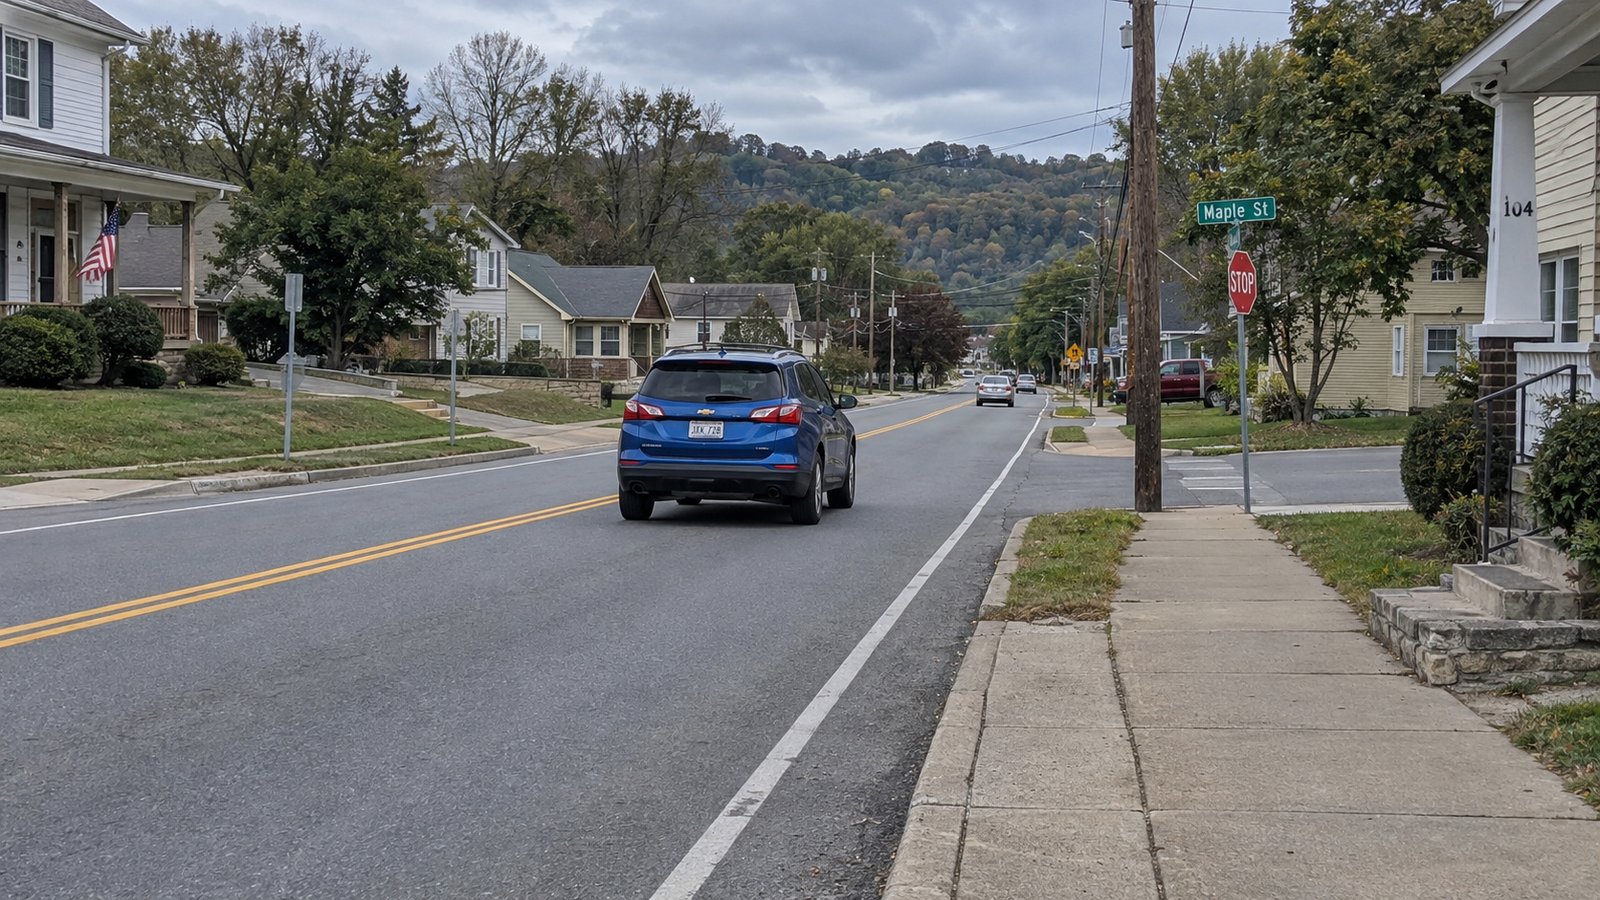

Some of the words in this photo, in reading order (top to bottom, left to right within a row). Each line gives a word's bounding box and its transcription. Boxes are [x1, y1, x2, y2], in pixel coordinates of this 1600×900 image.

[1203, 203, 1245, 222] Maple
[1253, 201, 1269, 217] St
[1504, 196, 1534, 217] 104
[1231, 270, 1254, 294] STOP
